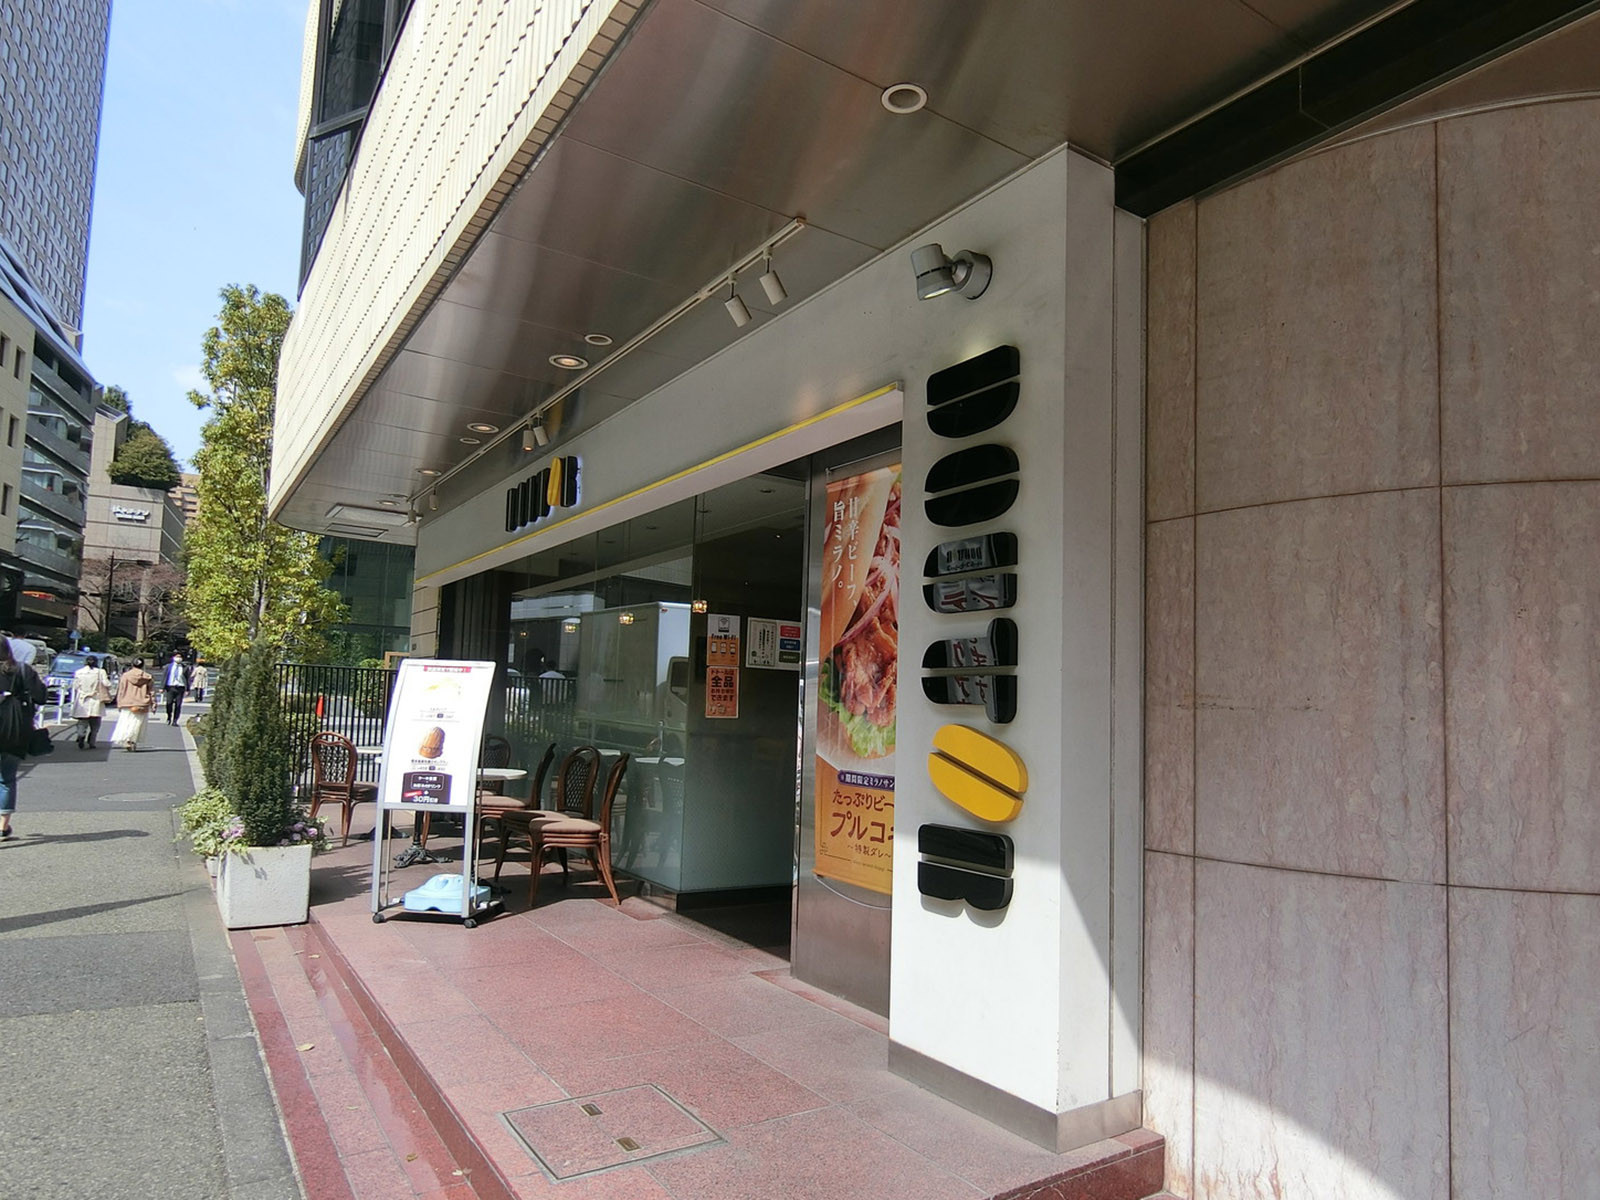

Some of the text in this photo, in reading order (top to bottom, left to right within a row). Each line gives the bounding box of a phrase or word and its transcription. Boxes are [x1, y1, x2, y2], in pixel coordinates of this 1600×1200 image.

[832, 501, 846, 590] 旨ミラノ。
[711, 675, 734, 688] 全品
